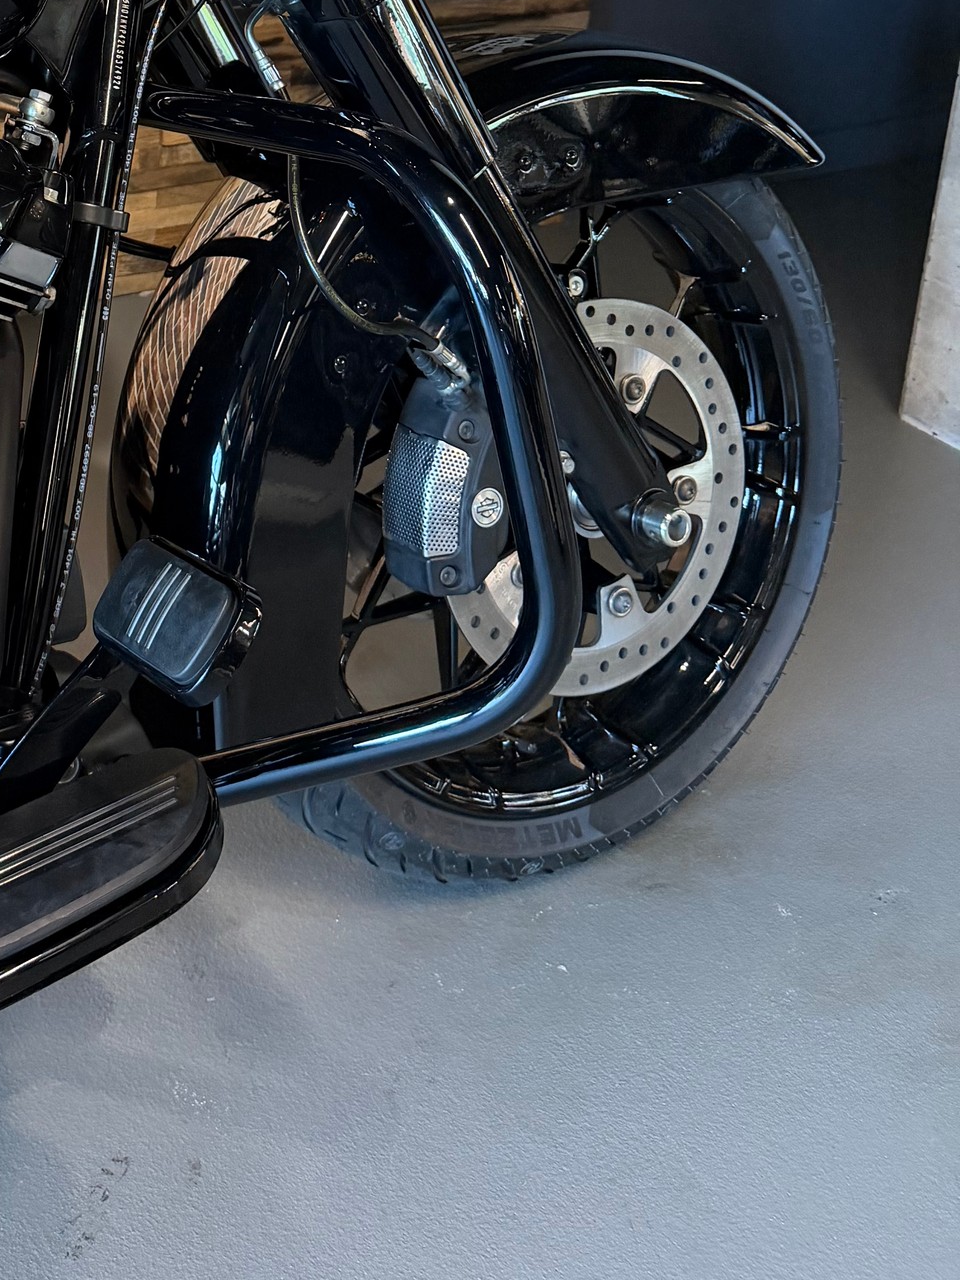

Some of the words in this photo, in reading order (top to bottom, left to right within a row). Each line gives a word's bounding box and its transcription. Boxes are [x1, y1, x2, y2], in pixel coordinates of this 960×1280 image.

[124, 148, 133, 173] 1401
[131, 104, 140, 123] DOT
[63, 547, 74, 575] 1401
[73, 498, 83, 520] DOT
